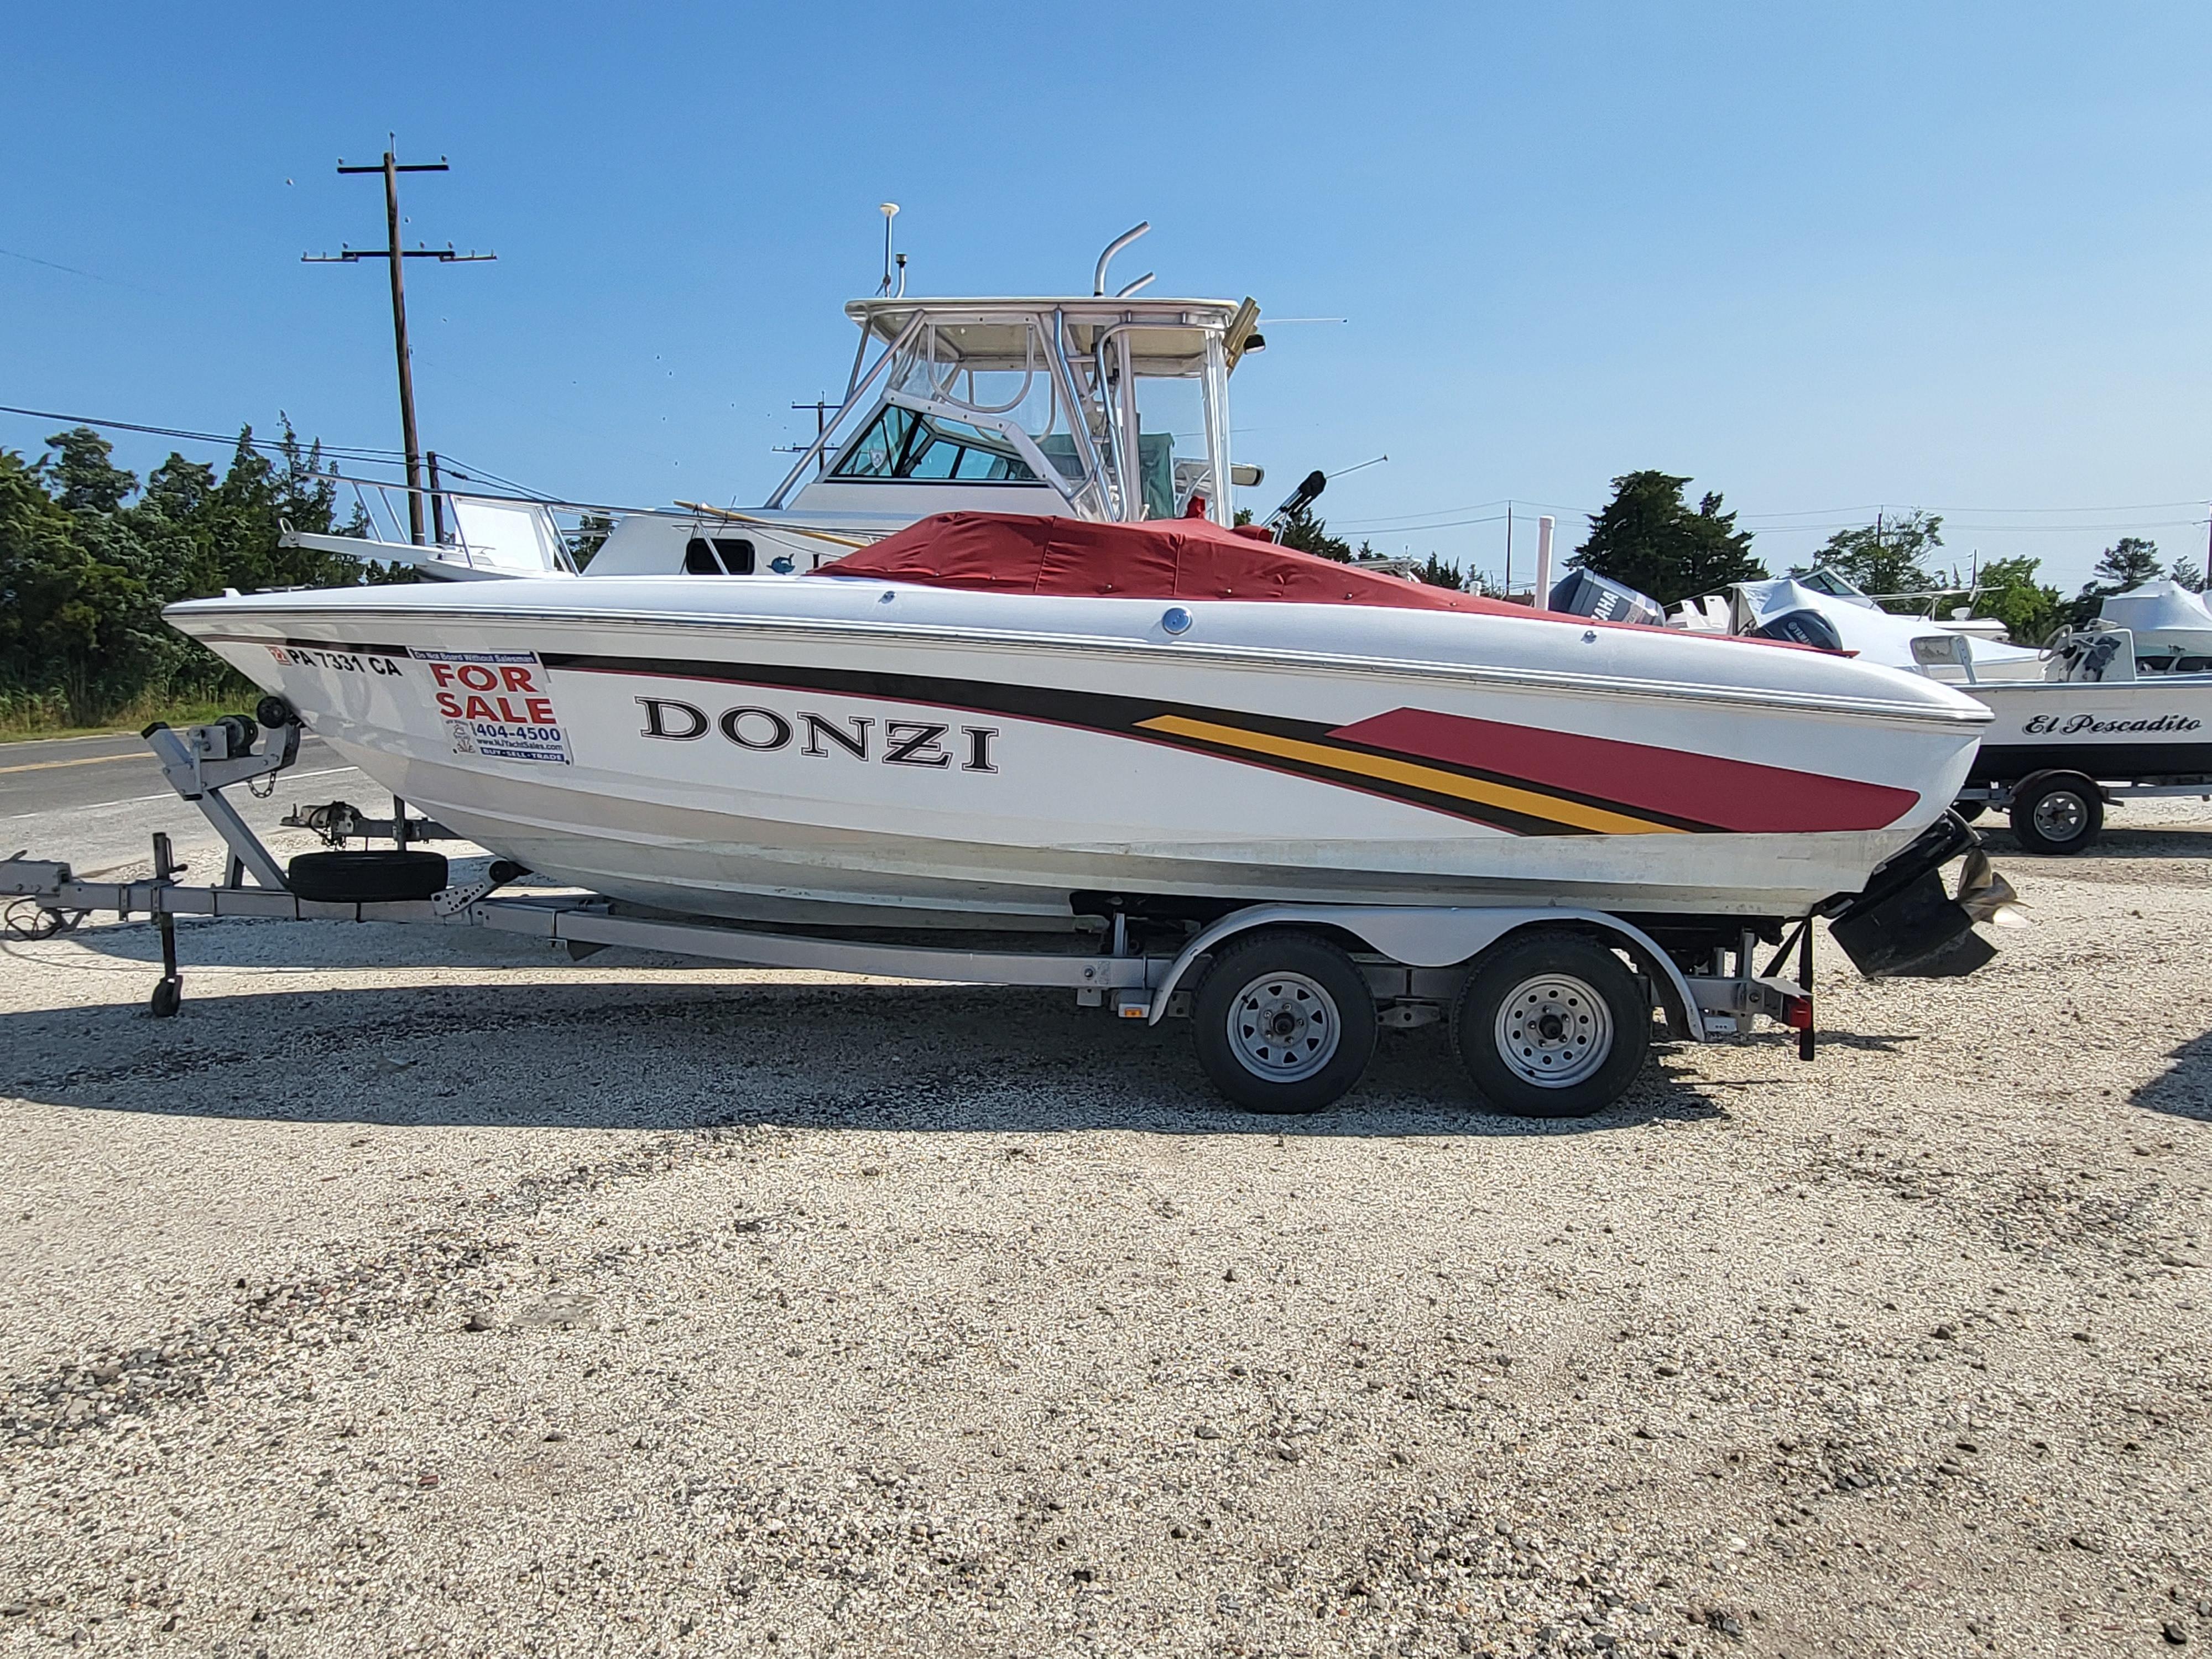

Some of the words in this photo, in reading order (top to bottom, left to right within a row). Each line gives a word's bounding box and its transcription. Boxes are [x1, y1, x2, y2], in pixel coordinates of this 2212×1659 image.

[1590, 591, 1619, 621] AHA
[285, 648, 318, 667] PA
[314, 652, 366, 673] 7331
[368, 657, 403, 676] CA
[429, 663, 540, 692] FOR
[435, 692, 557, 724] SALE
[634, 695, 1000, 774] DONZI
[2022, 715, 2060, 736] El
[2059, 713, 2202, 736] Pescadito
[476, 738, 563, 752] www.NJYachtSales.com
